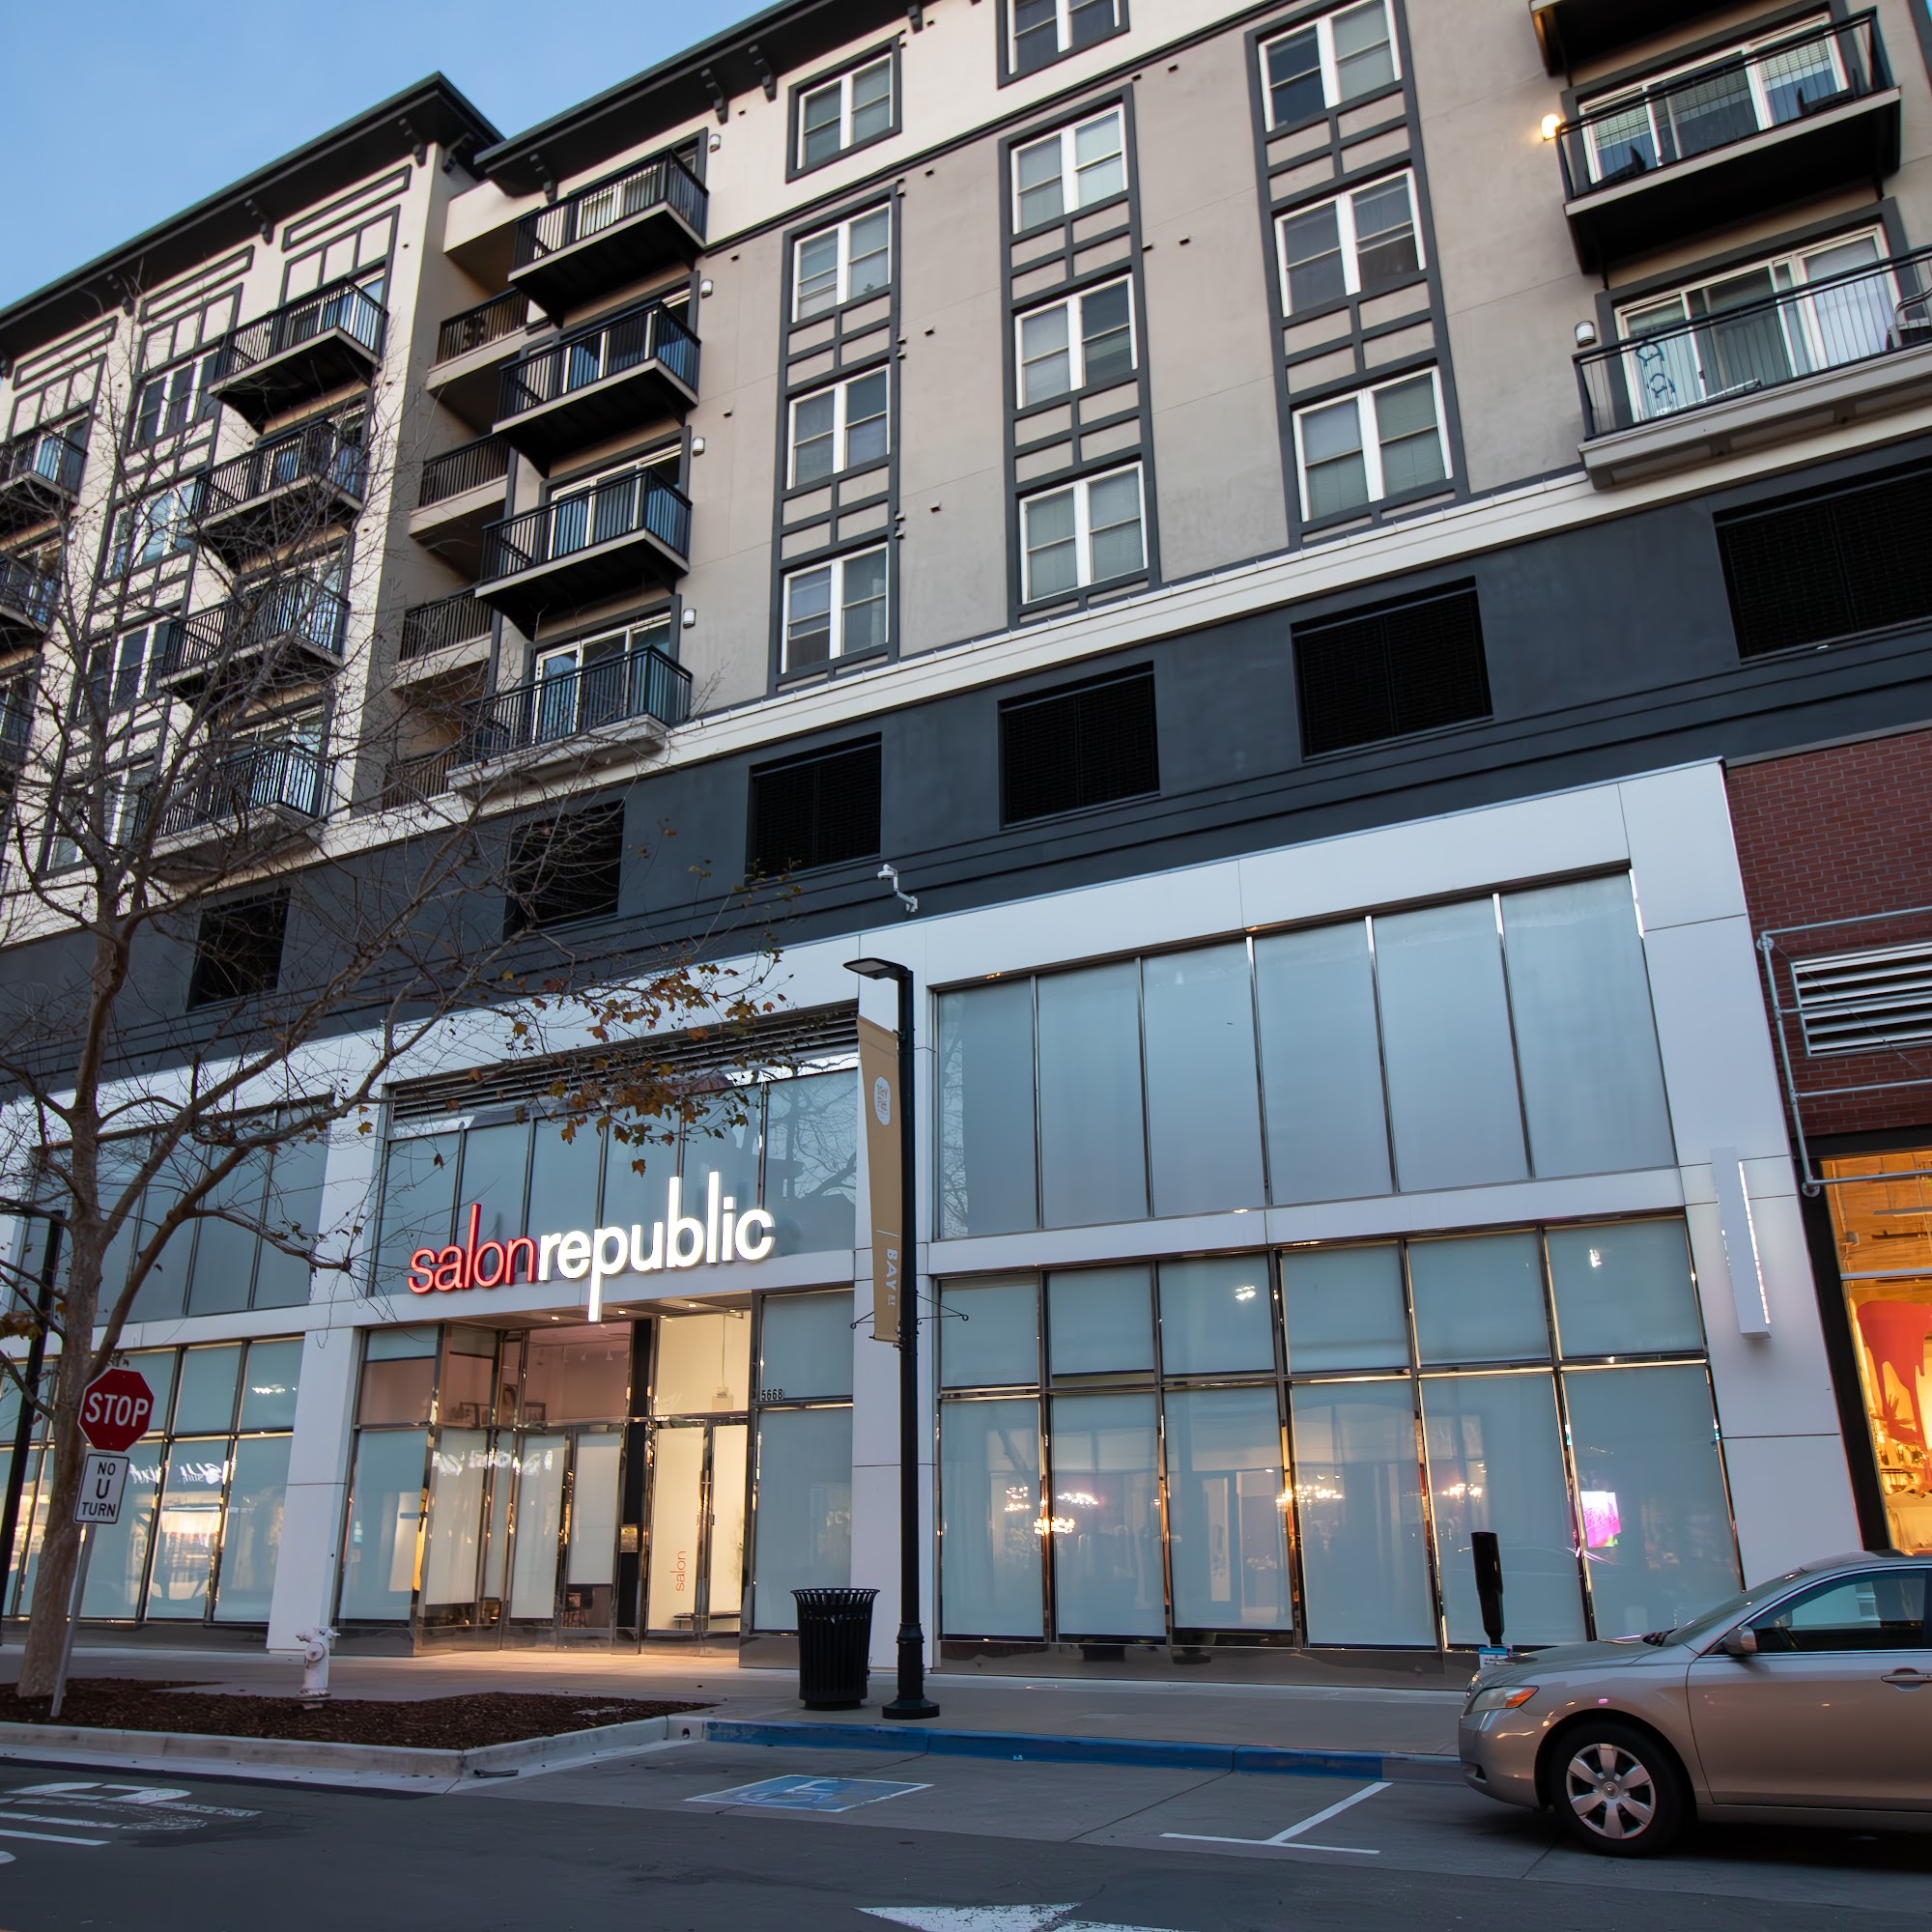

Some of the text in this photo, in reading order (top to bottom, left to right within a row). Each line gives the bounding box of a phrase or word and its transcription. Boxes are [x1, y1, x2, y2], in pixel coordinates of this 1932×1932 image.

[886, 1248, 897, 1292] BAY
[761, 1388, 783, 1401] 5668
[85, 1392, 149, 1427] STOP
[98, 1462, 116, 1476] NO
[97, 1479, 111, 1499] U
[82, 1501, 117, 1518] TURN
[669, 1550, 686, 1591] salon
